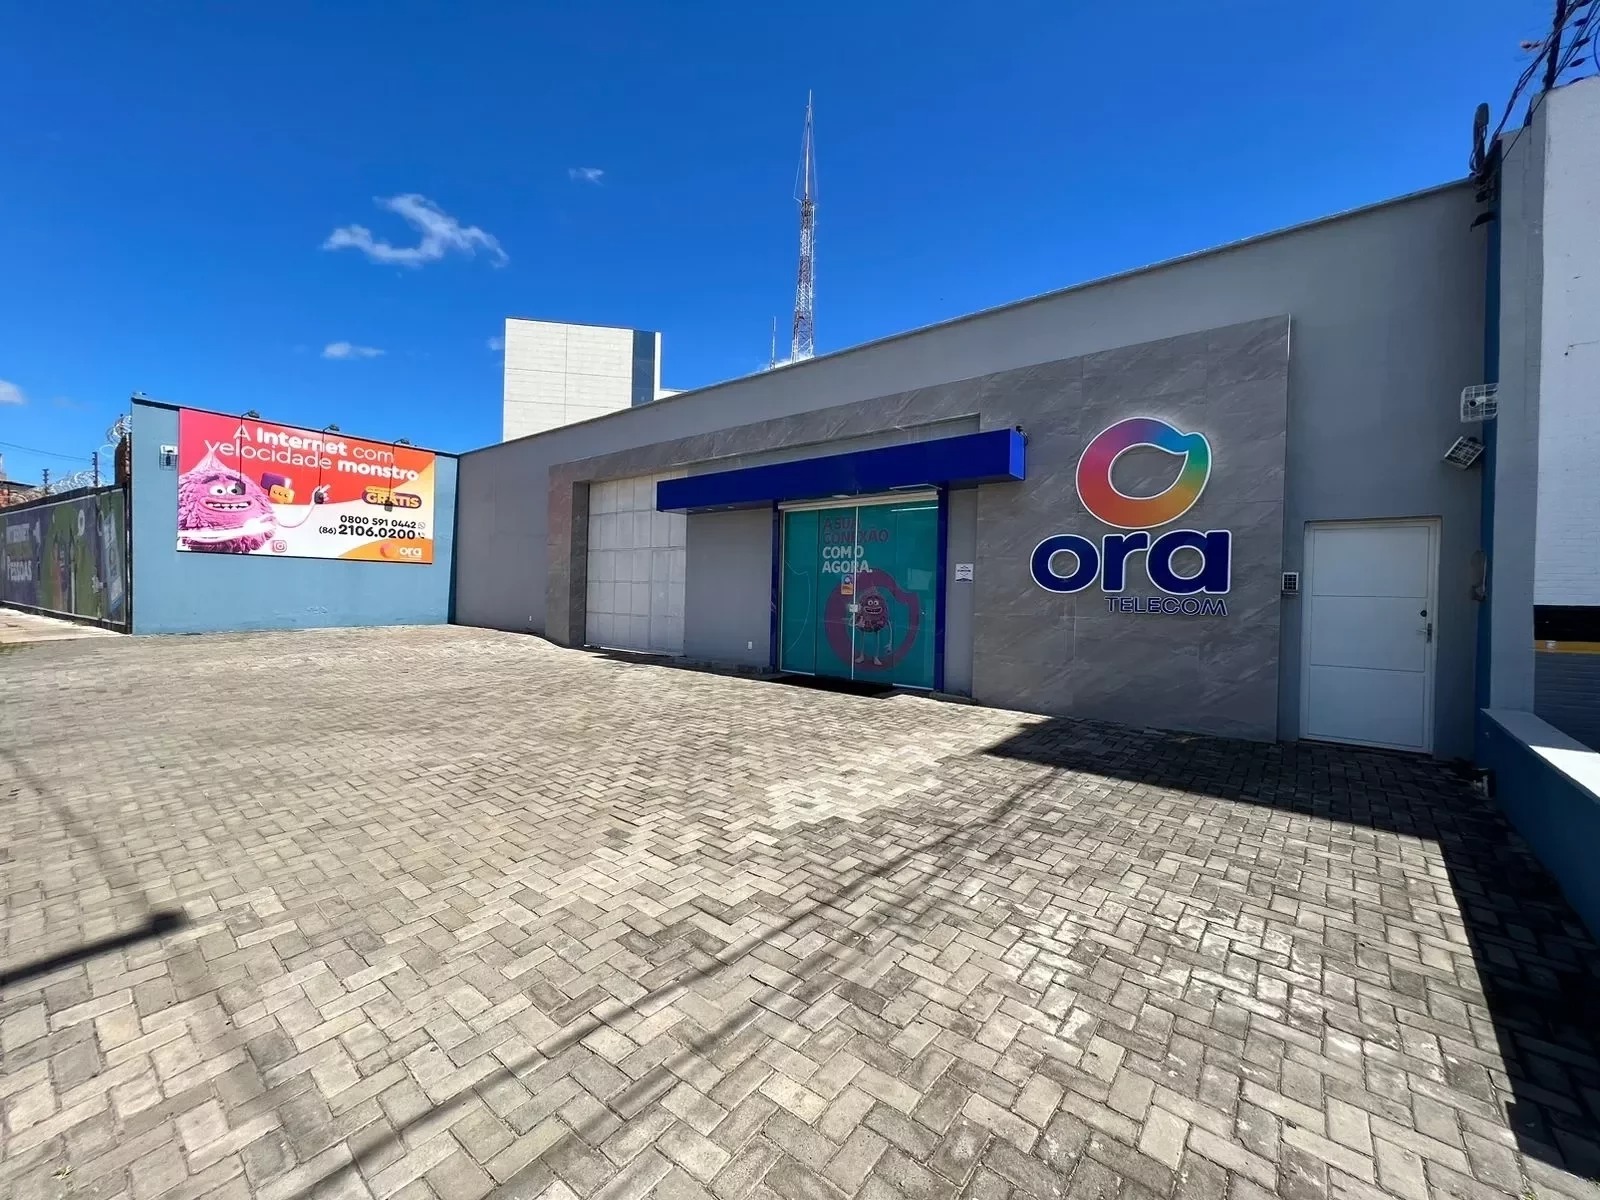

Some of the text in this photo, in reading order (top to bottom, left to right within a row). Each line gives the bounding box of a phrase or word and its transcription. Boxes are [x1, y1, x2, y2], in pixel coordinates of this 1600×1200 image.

[233, 424, 394, 463] A Internet com
[204, 440, 419, 480] velocidade monstro
[340, 515, 416, 529] 0800 591 0442
[319, 524, 415, 540] (86) 2106.0200
[400, 547, 422, 556] ora
[822, 560, 873, 574] AGORA.
[1030, 529, 1232, 595] ora
[1104, 596, 1228, 616] TELECOM
